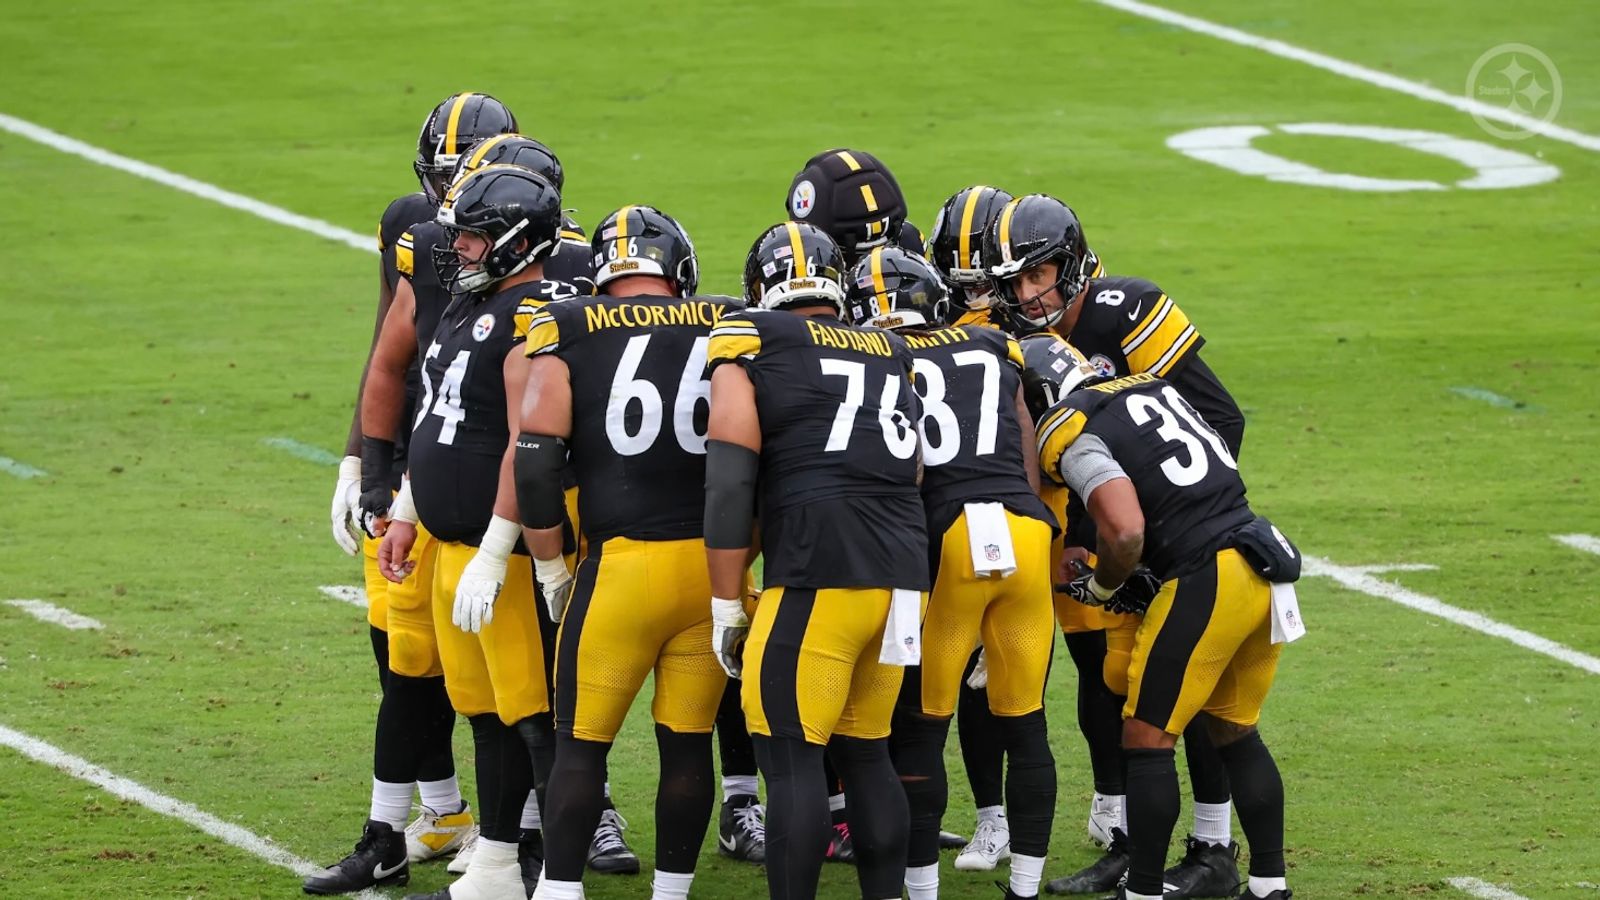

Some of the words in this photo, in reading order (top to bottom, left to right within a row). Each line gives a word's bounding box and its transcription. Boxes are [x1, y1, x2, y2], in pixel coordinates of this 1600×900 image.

[608, 236, 638, 260] 66
[952, 250, 981, 269] 14
[609, 260, 639, 273] Steelers
[783, 256, 816, 280] 76
[789, 279, 817, 290] Steelers
[869, 291, 897, 316] 87
[1095, 289, 1125, 306] 8
[584, 301, 725, 333] McCORMICK
[806, 319, 893, 357] FAUTANU
[906, 327, 970, 349] MITH
[605, 333, 711, 456] 66
[819, 358, 917, 459] 76
[912, 349, 1001, 467] 87
[1126, 385, 1237, 486] 30
